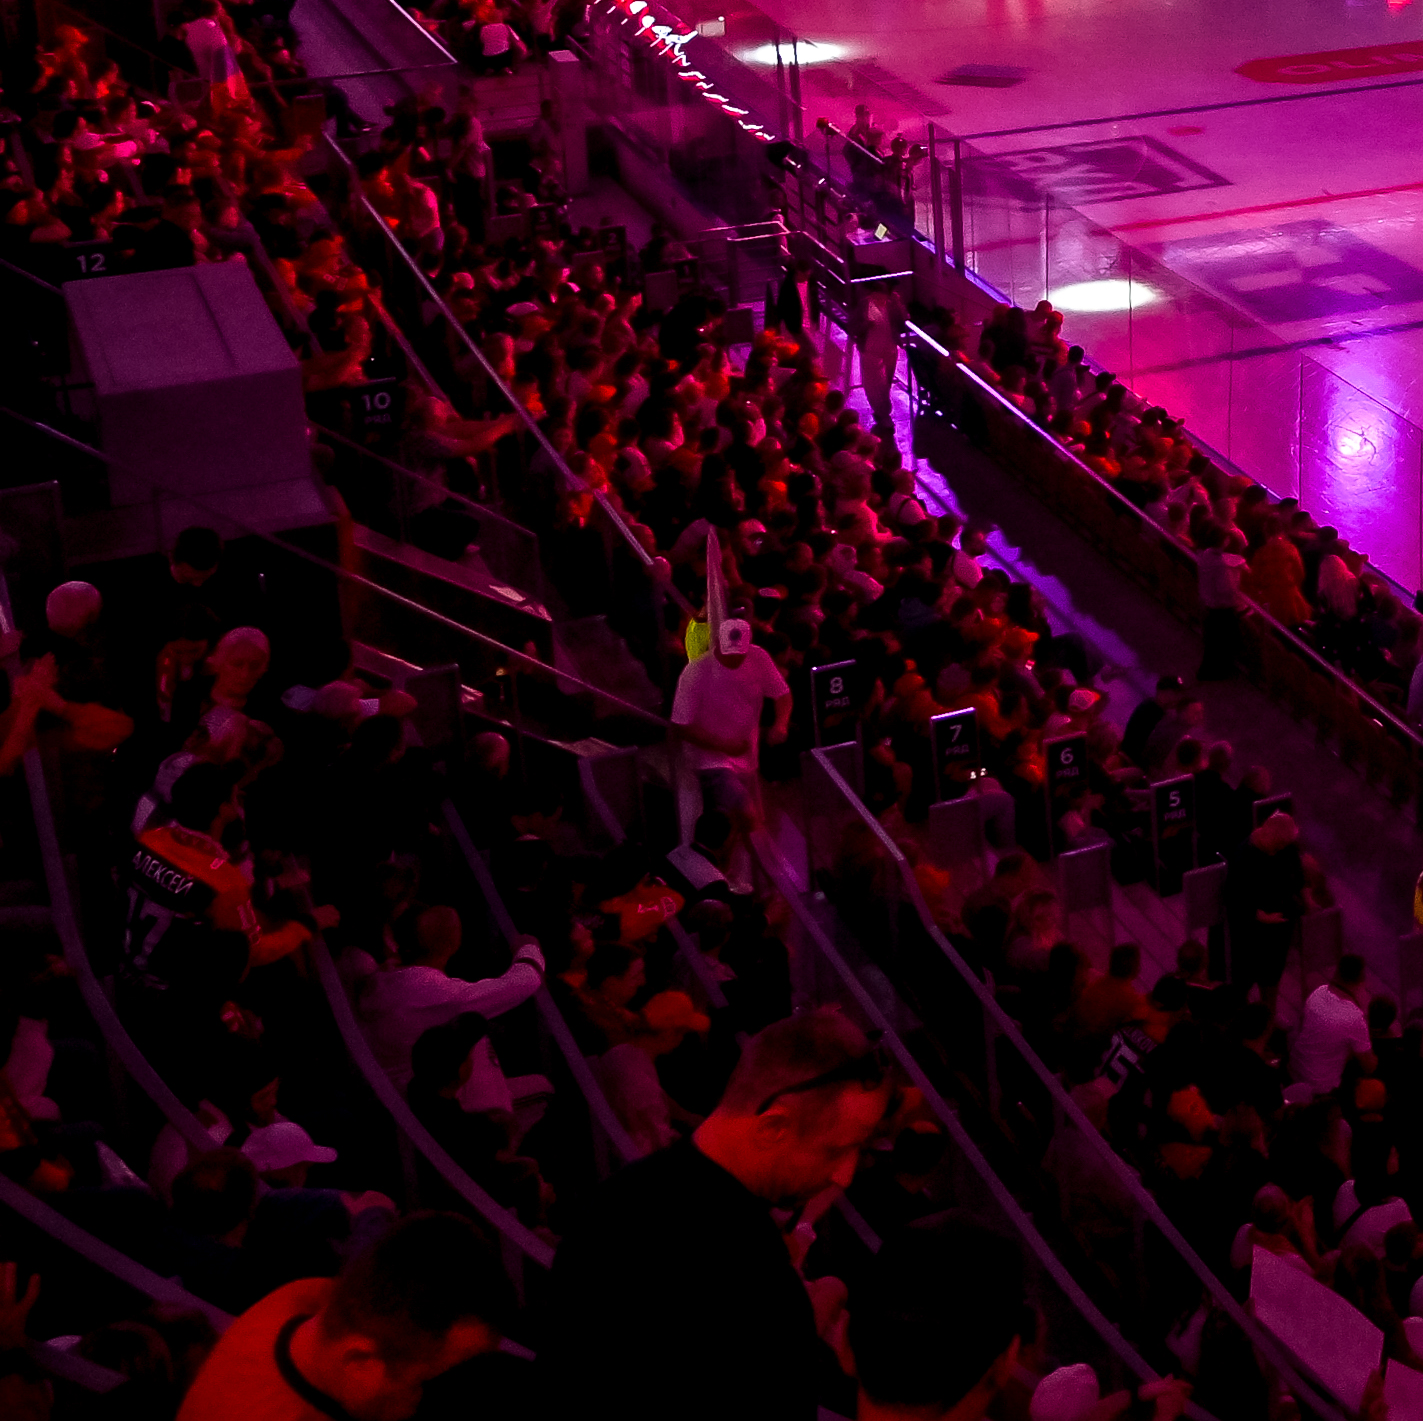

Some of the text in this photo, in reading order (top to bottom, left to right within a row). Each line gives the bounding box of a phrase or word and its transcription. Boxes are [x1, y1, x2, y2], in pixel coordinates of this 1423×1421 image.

[76, 252, 108, 275] 12
[360, 391, 393, 412] 10
[829, 676, 845, 694] 8
[949, 724, 963, 744] 7
[1060, 748, 1074, 765] 6
[1169, 790, 1181, 807] 5
[132, 849, 194, 896] АЛЕКСЕЙ
